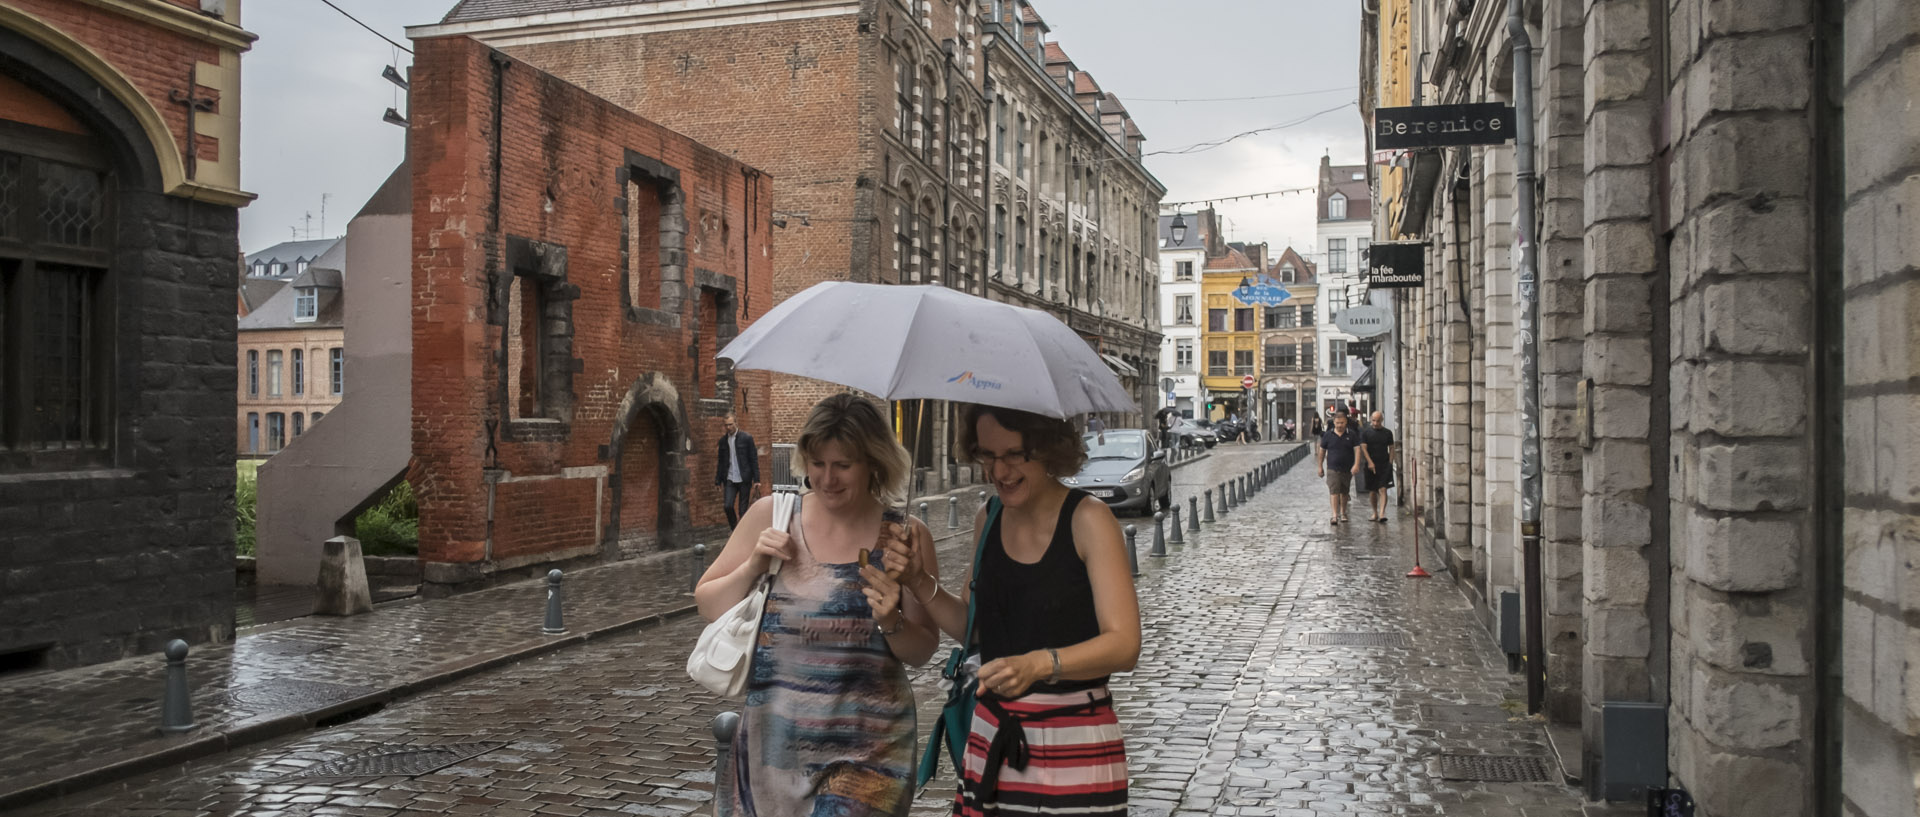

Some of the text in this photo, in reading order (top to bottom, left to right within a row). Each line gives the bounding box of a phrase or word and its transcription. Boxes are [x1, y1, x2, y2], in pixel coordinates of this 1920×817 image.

[1379, 116, 1502, 136] Berenice
[1371, 264, 1394, 276] la fée
[1371, 273, 1422, 283] maraboutée
[968, 376, 1002, 390] Appia
